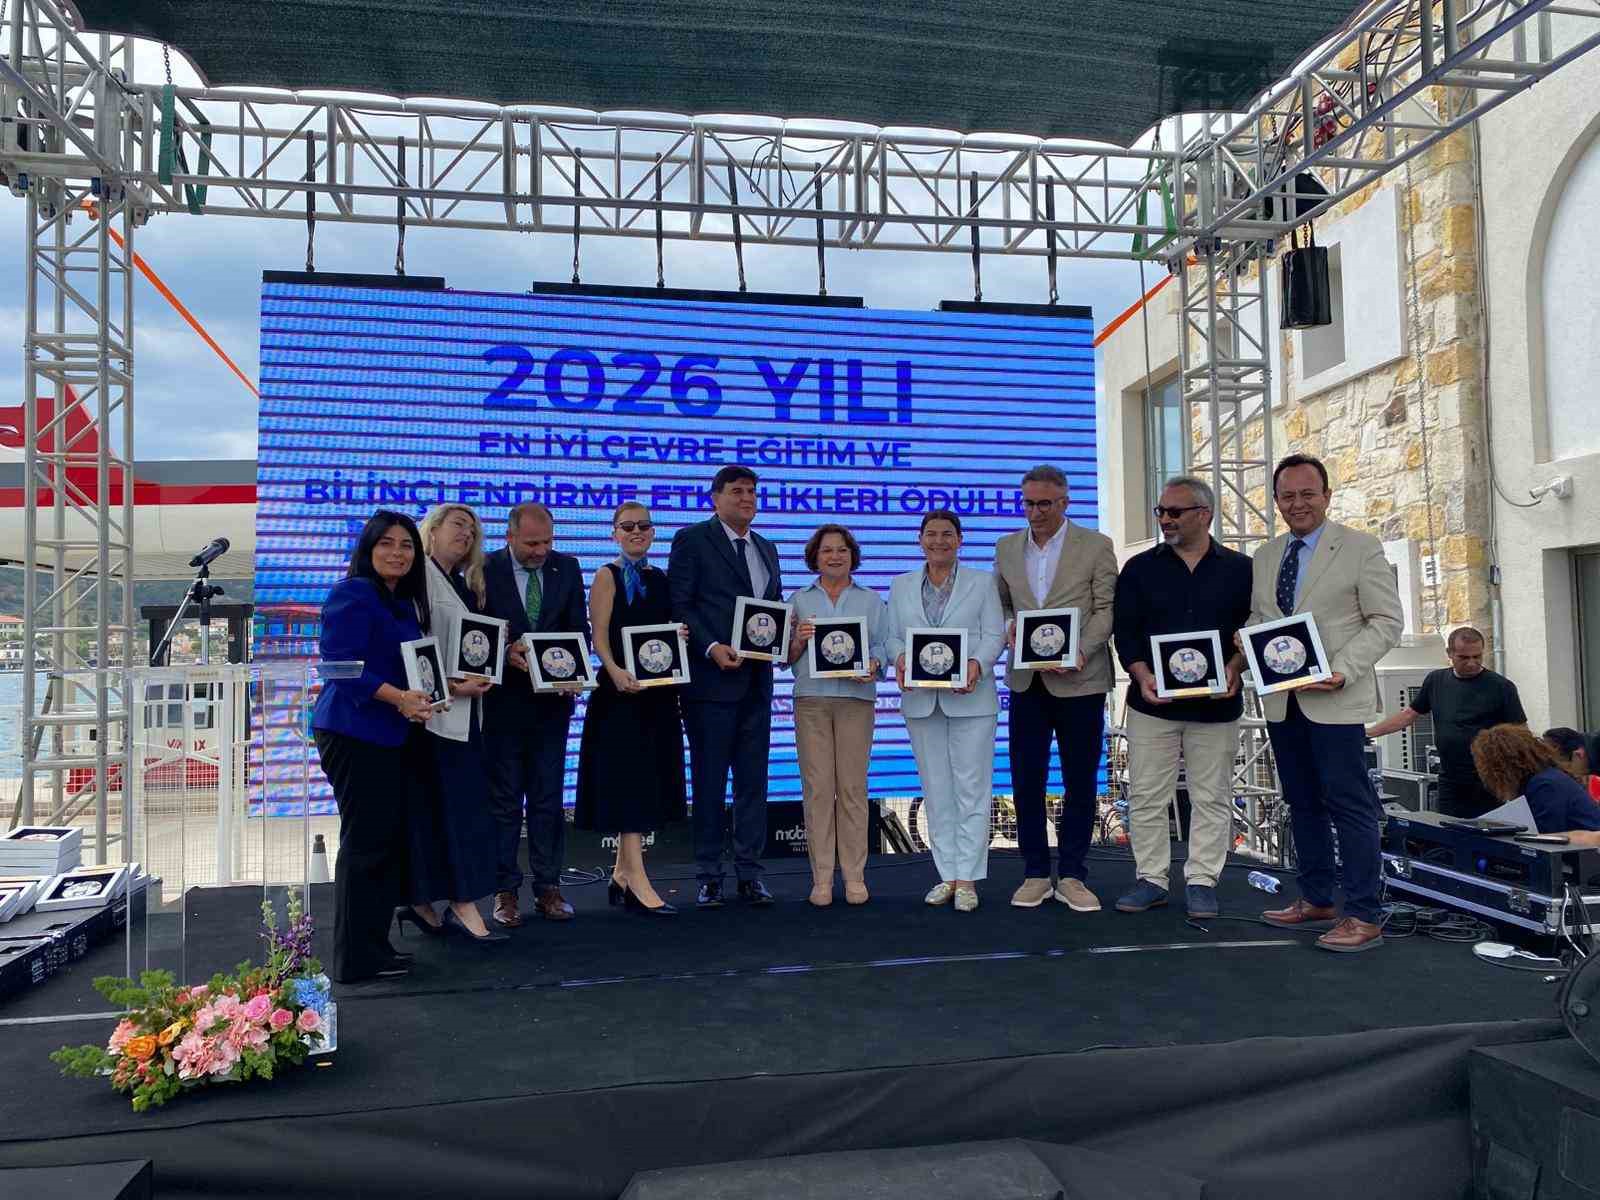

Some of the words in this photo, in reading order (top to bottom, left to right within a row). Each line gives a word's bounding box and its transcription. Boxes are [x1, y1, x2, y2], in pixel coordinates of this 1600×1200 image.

[482, 345, 722, 417] 2026
[752, 357, 912, 424] YILI
[479, 432, 530, 455] EN
[544, 428, 588, 459] İYİ
[601, 435, 724, 468] ÇEVRE
[736, 433, 856, 466] EĞİTİM
[866, 442, 912, 467] VE
[651, 484, 888, 513] ETKLİKLERİ
